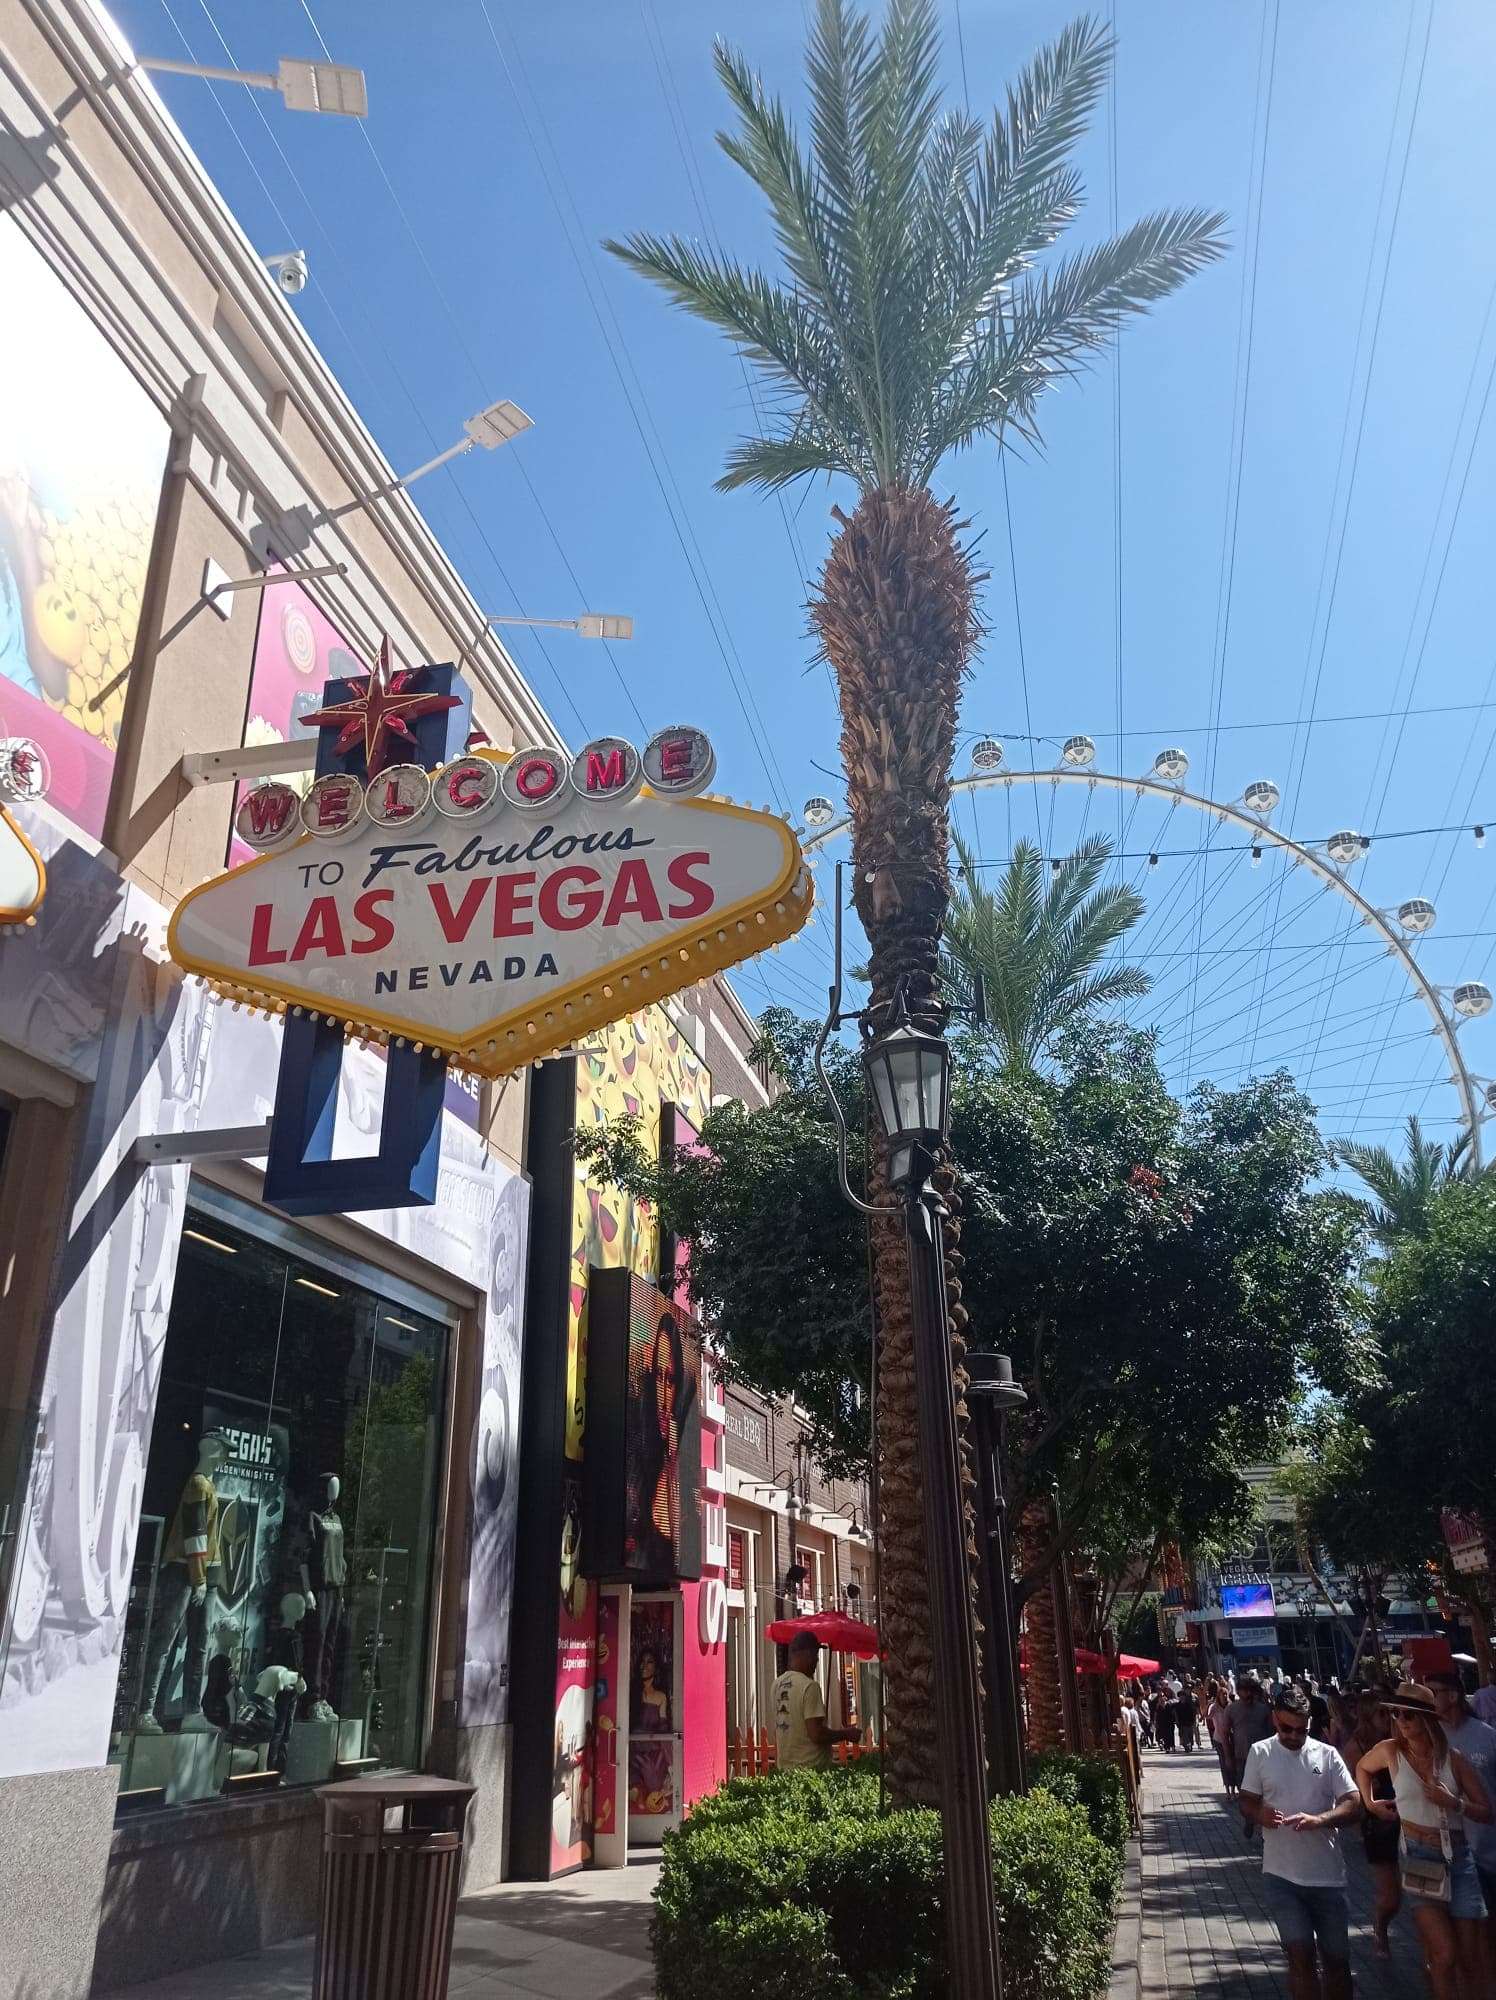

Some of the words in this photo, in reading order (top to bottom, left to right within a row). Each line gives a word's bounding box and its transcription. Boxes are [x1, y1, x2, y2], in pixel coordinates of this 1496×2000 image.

[249, 737, 696, 837] WELCOME
[299, 861, 344, 889] TO
[362, 824, 655, 889] Fabulous
[247, 889, 395, 968] LAS
[427, 852, 715, 945] VEGAS
[374, 952, 560, 995] NEVADA
[219, 1426, 273, 1464] EGAS
